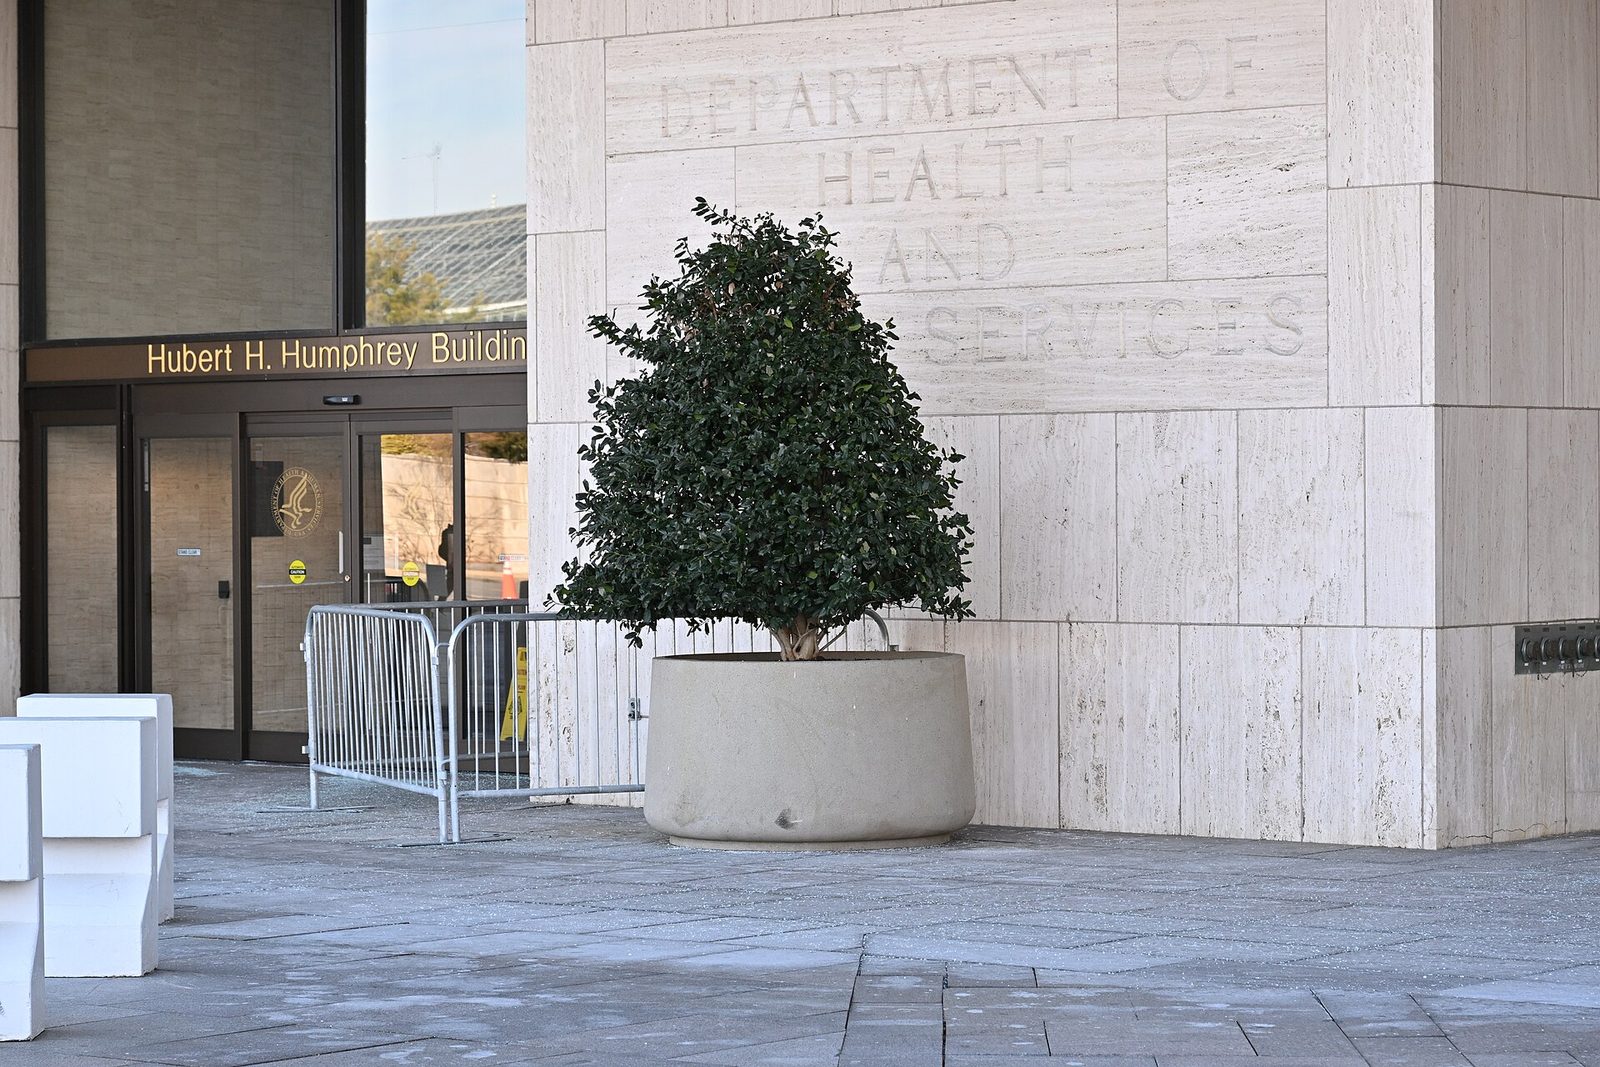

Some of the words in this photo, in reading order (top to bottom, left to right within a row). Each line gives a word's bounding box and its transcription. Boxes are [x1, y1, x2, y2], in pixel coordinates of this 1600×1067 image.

[660, 49, 1092, 138] DEPARTMENT
[1162, 35, 1257, 102] OF
[817, 135, 1074, 206] HEALTH
[879, 223, 1015, 285] AND
[147, 343, 233, 374] Hubert
[245, 341, 271, 371] H.
[281, 337, 419, 371] Humphrey
[432, 330, 527, 364] Buildin
[924, 294, 1305, 365] SERVICES
